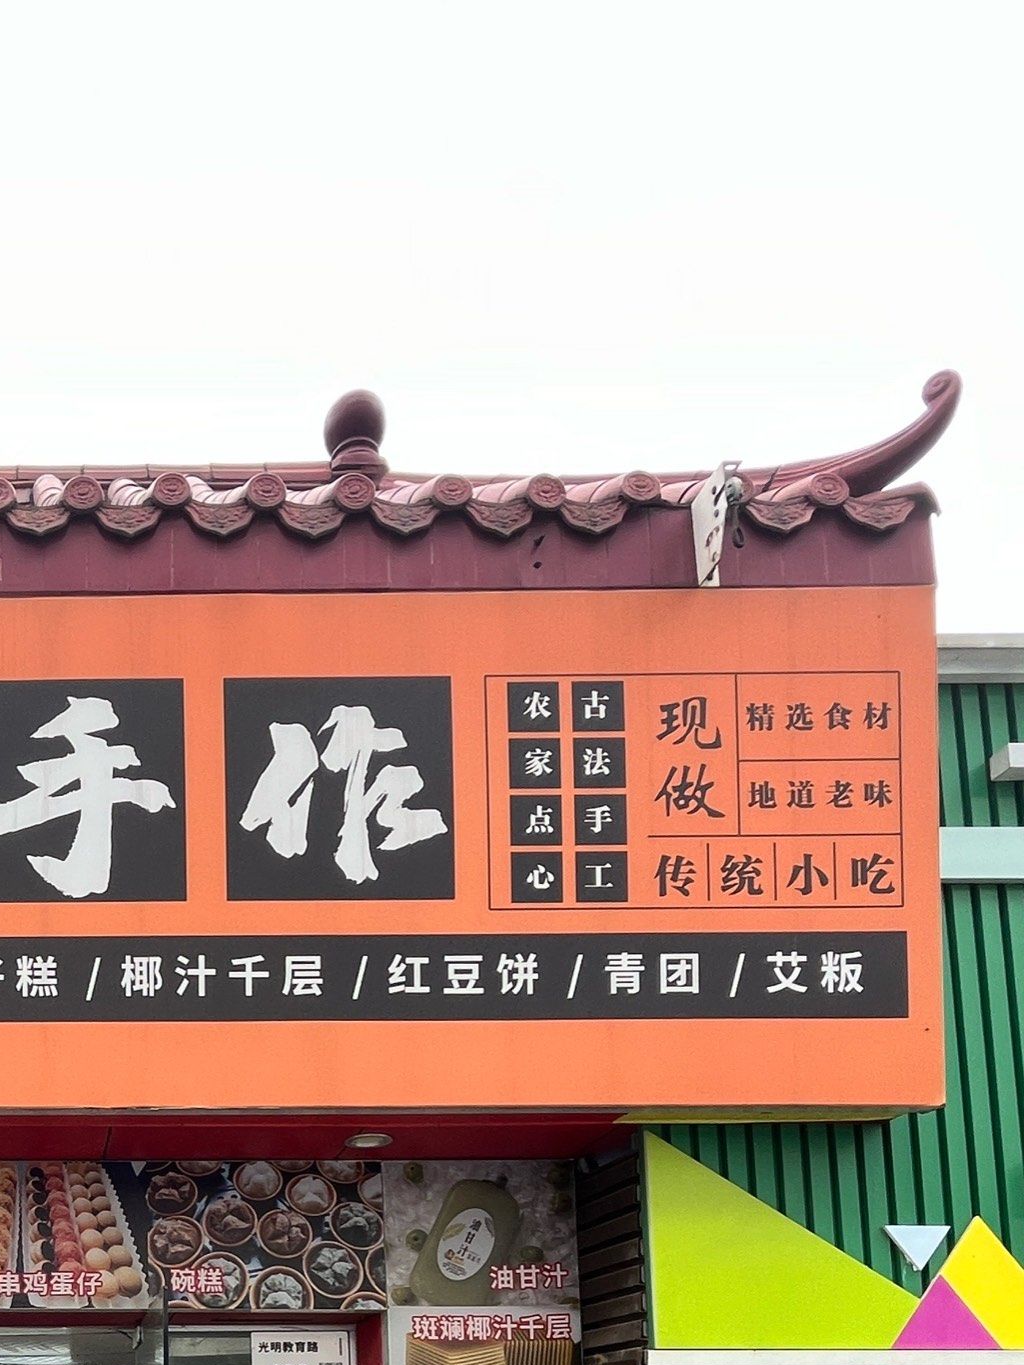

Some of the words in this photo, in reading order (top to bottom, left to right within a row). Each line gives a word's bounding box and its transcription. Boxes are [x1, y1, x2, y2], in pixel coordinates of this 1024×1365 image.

[745, 702, 892, 731] 精选食材
[654, 696, 726, 819] 现做
[523, 692, 555, 889] 农家点心
[579, 692, 615, 888] 古法手工
[748, 780, 893, 809] 地道老味
[655, 853, 896, 898] 传统小吃
[121, 955, 324, 996] 椰汁千层
[387, 954, 540, 996] 红豆饼
[604, 952, 700, 994] 青团
[170, 1268, 223, 1293] 碗糕
[490, 1265, 569, 1290] 油甘汁
[413, 1315, 572, 1341] 斑斓椰汁千层
[258, 1341, 318, 1353] 光明教育路
